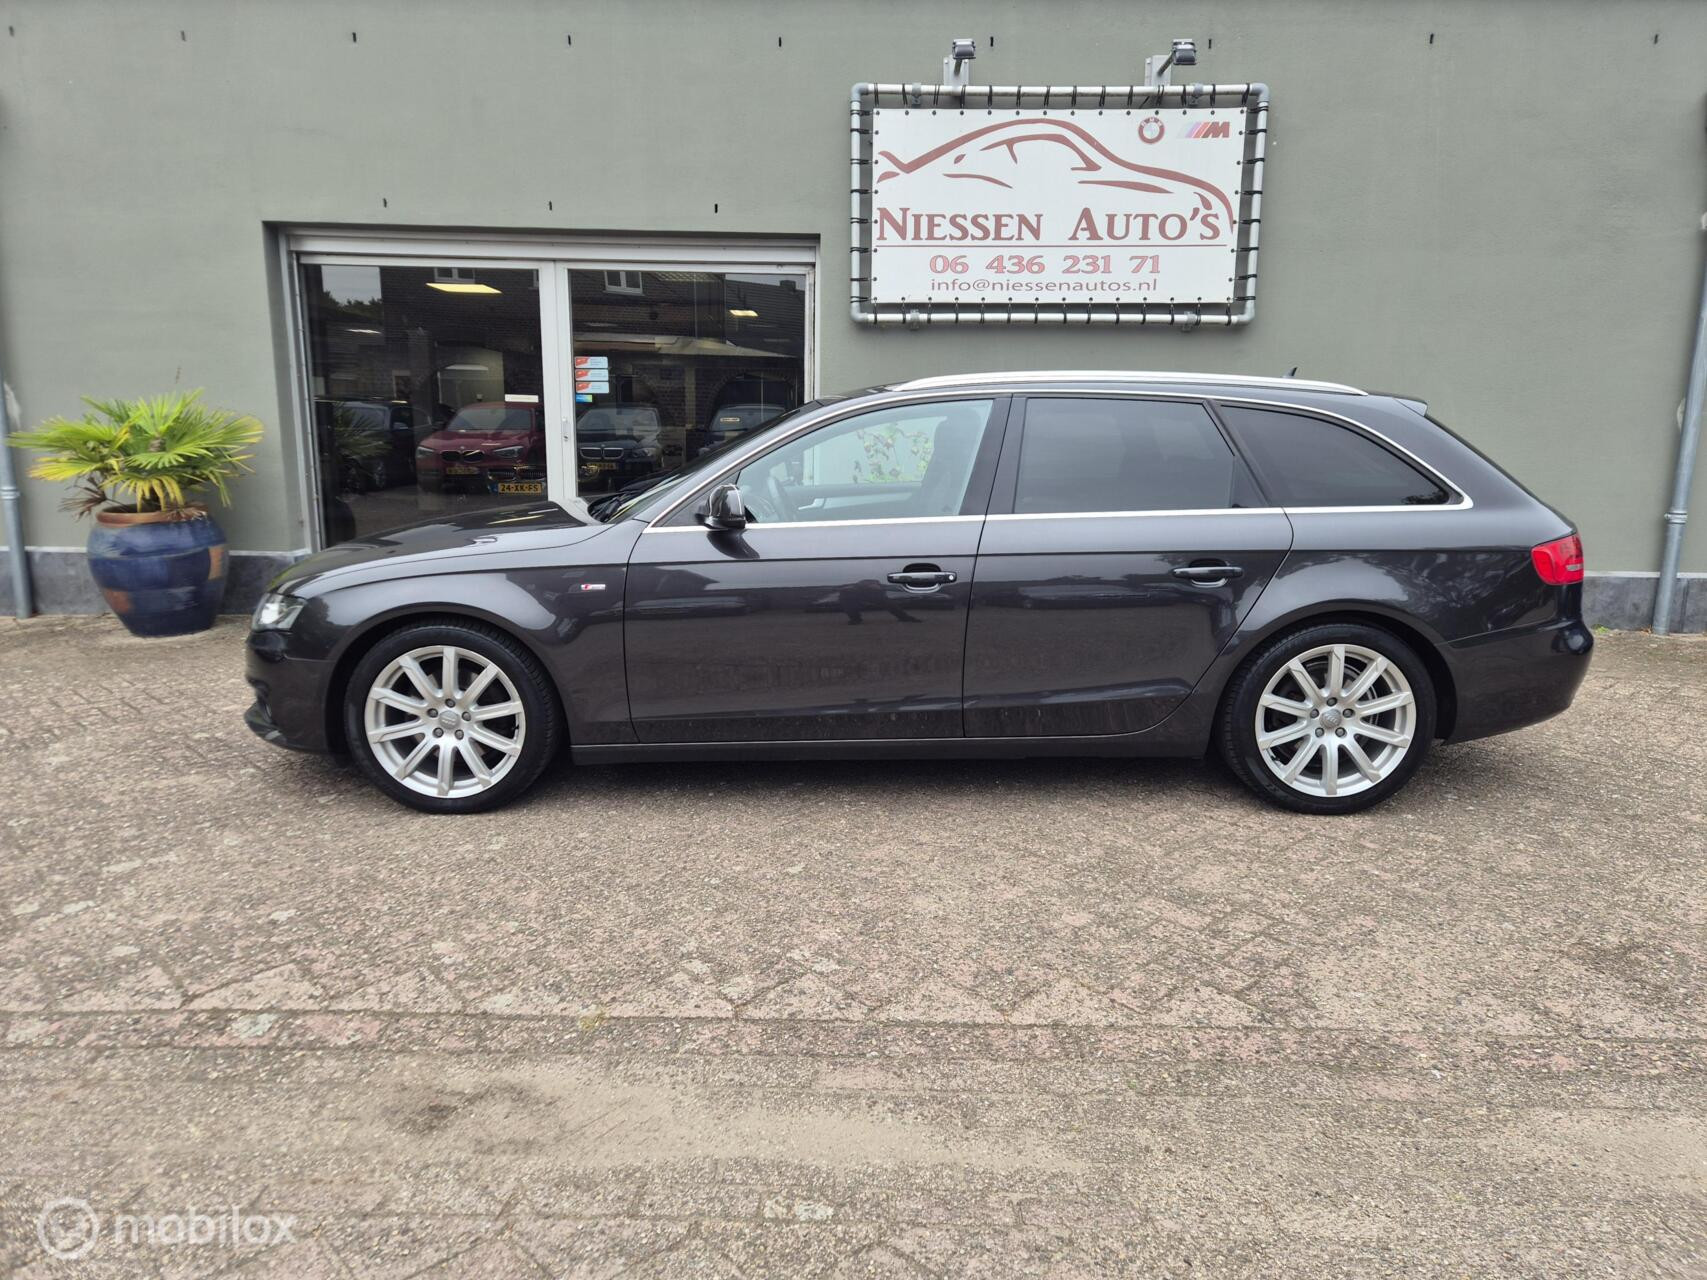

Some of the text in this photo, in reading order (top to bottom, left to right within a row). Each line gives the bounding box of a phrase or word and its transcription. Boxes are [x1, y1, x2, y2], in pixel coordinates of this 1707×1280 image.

[876, 207, 1043, 241] NIESSEN
[929, 254, 1160, 274] 06 436 231 71
[931, 278, 1157, 292] info@niessenautos.nl
